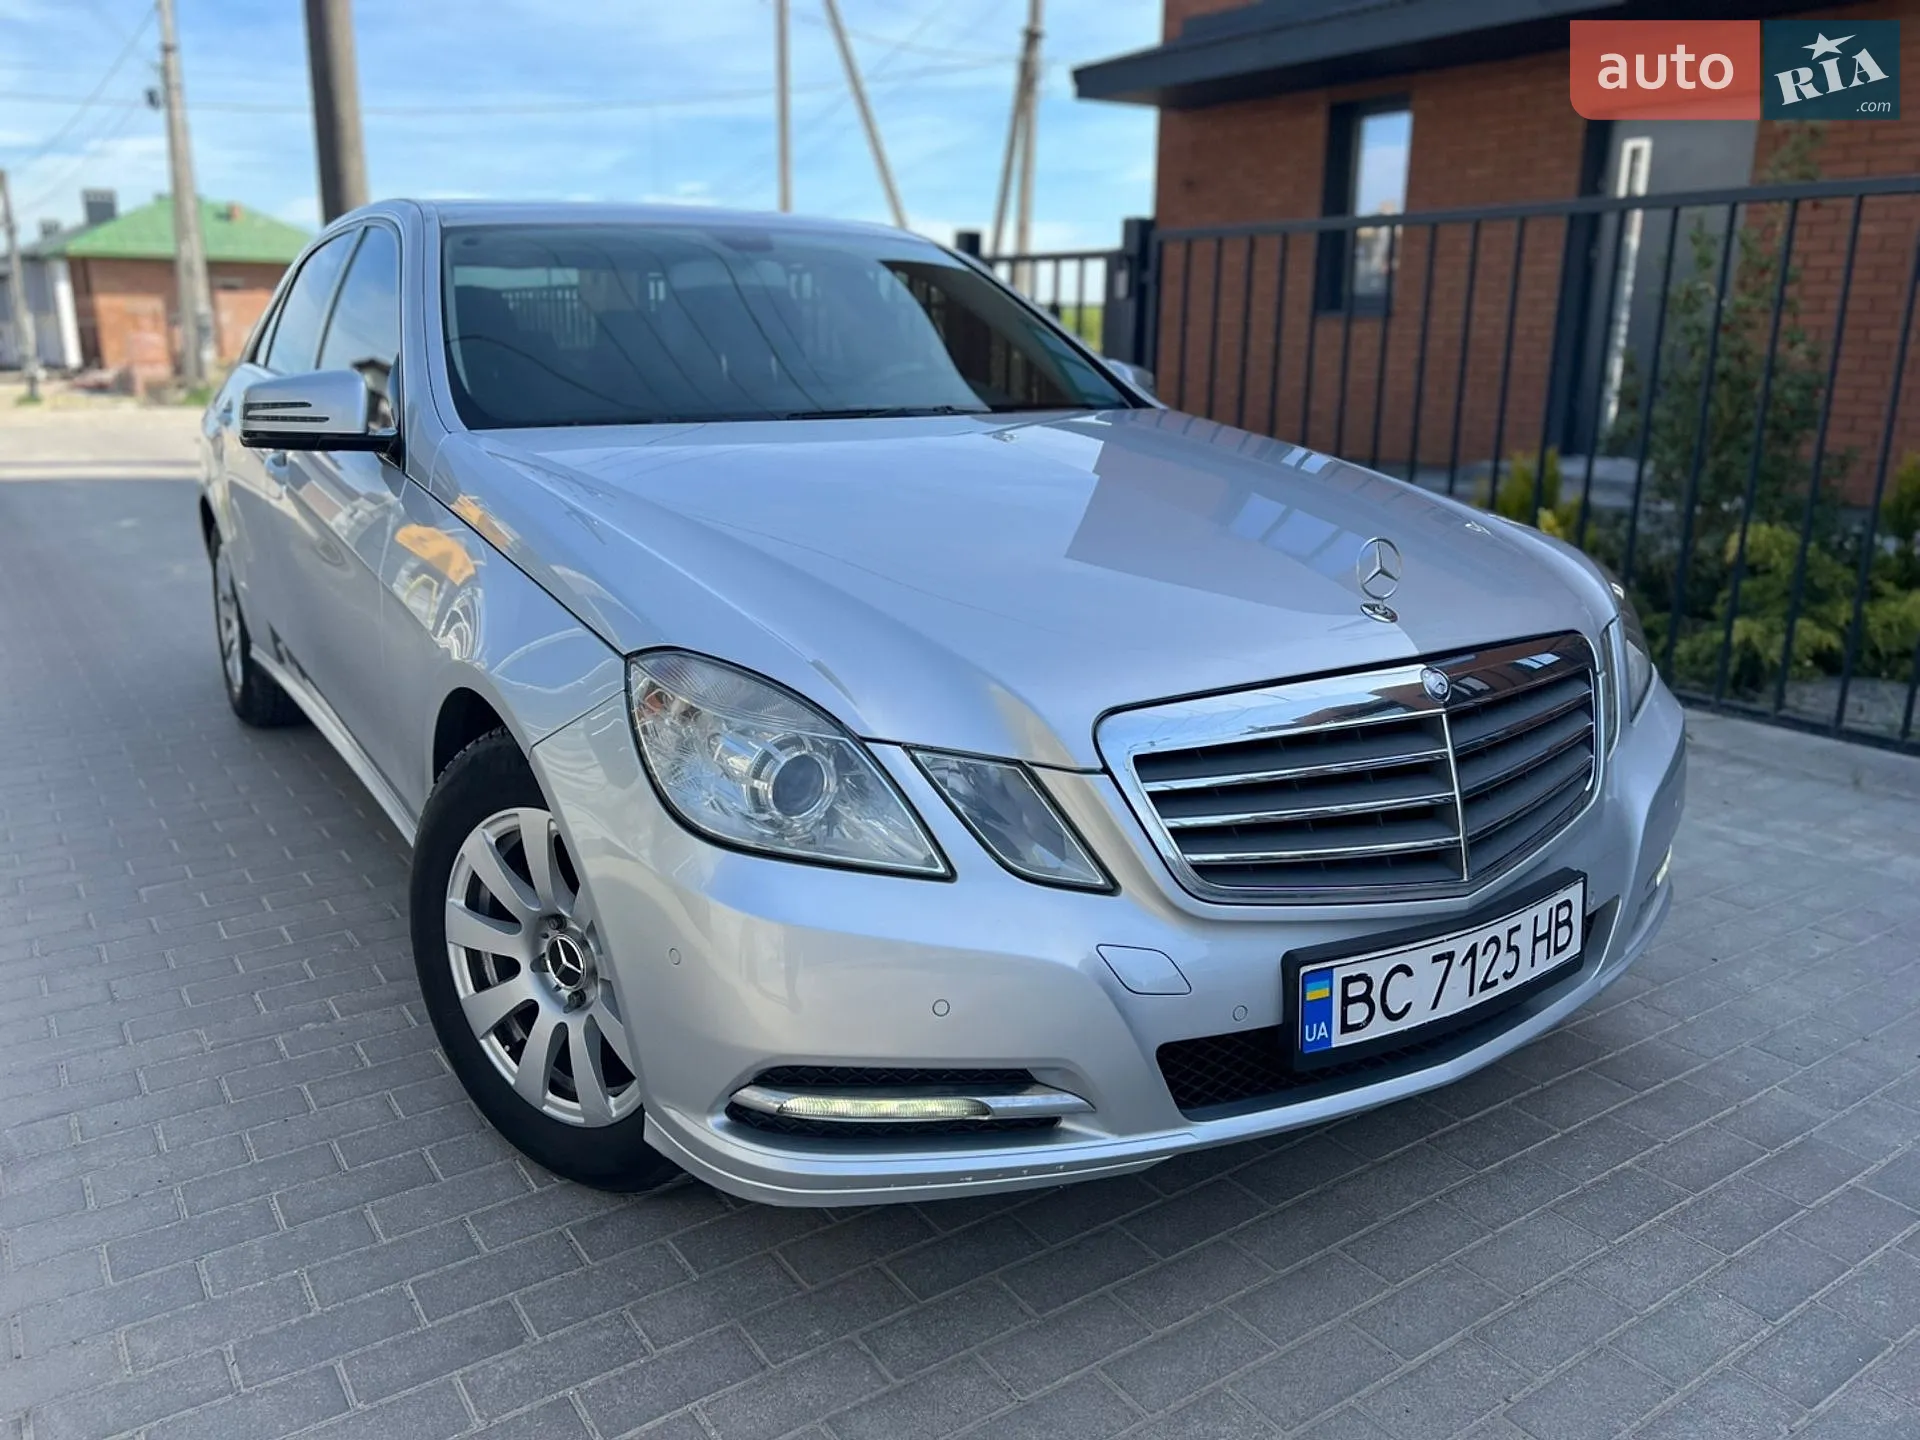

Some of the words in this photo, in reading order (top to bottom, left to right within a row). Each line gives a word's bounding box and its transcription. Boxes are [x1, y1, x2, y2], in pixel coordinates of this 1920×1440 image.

[1340, 963, 1414, 1035] BC
[1430, 925, 1521, 1011] 7125
[1530, 899, 1574, 969] HB
[1304, 1023, 1329, 1042] UA
